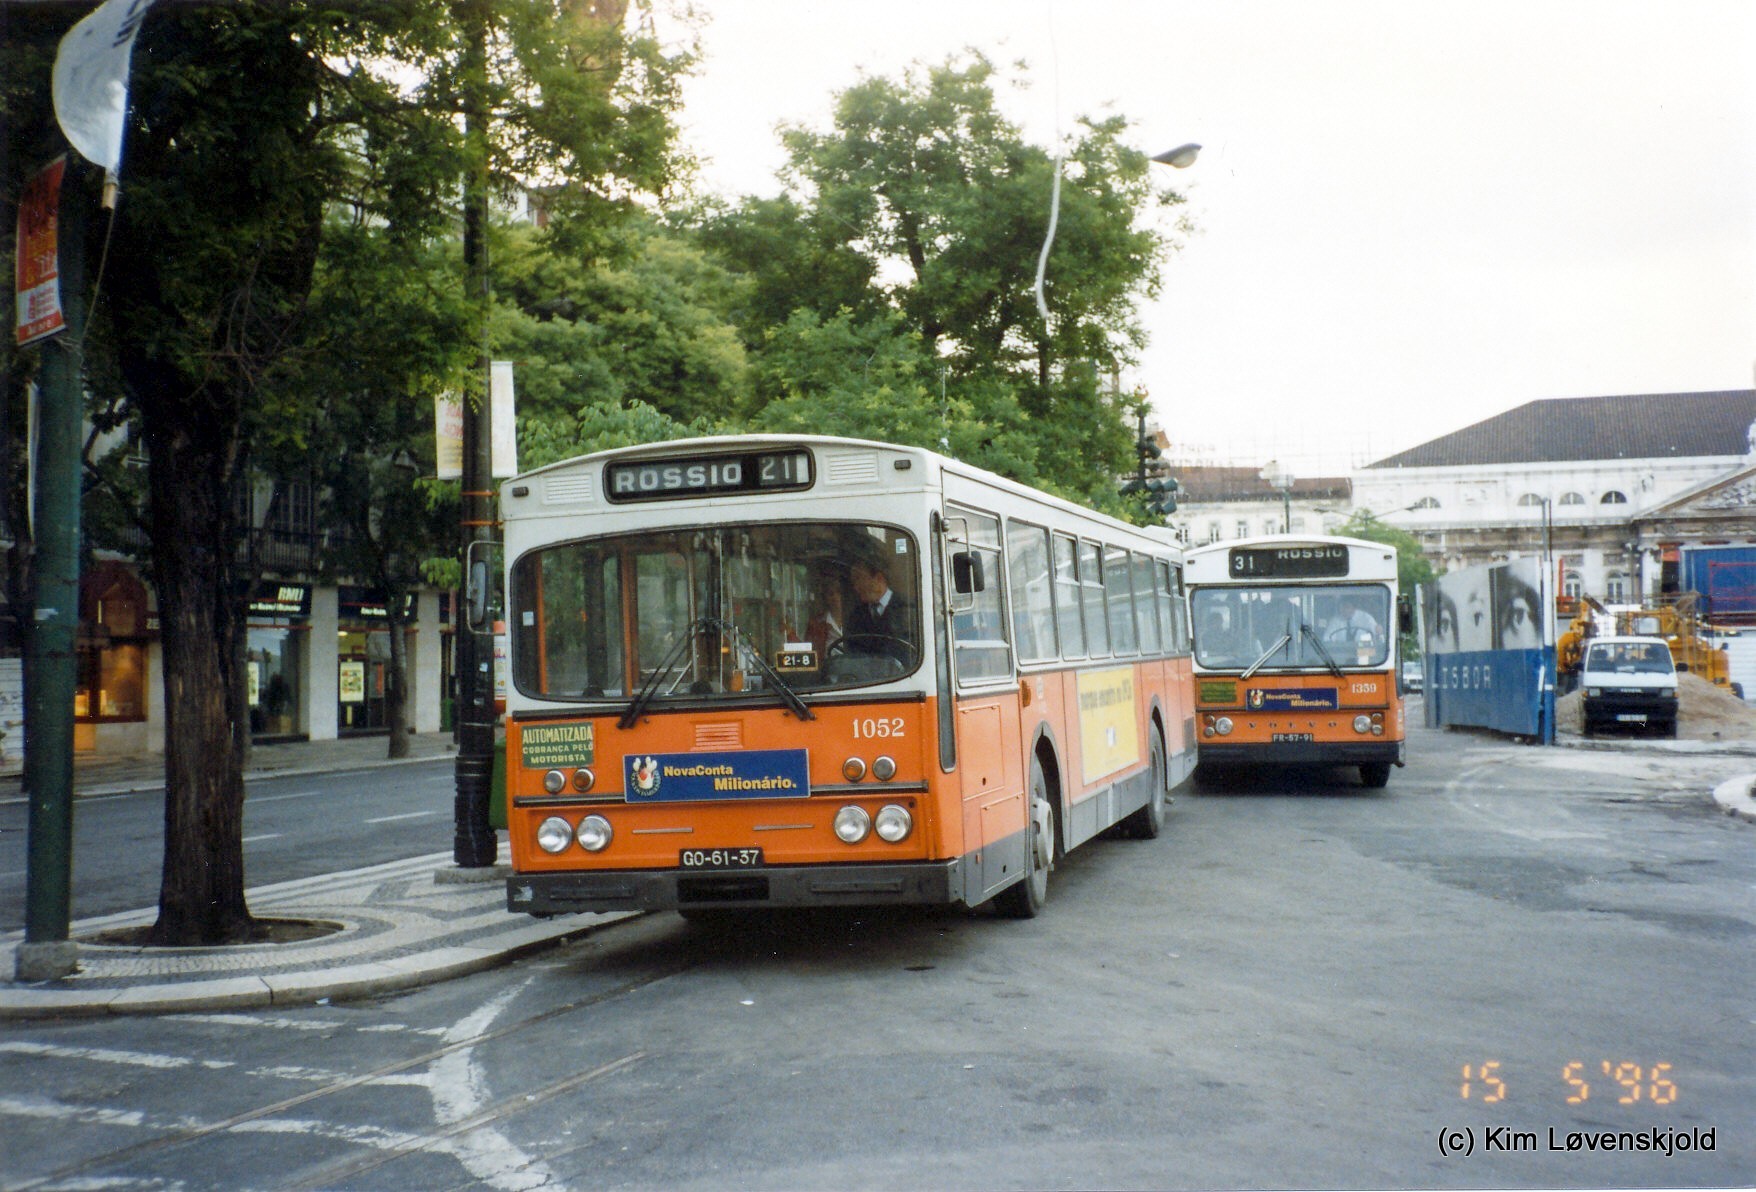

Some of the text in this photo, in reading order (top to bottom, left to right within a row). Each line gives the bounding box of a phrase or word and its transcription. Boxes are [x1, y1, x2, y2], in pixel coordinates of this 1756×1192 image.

[615, 456, 790, 493] ROSSIO 21
[1234, 555, 1254, 573] 31
[783, 655, 810, 666] 21-8
[522, 725, 594, 744] AUTOMATIZADA
[852, 717, 905, 738] 1052
[522, 744, 570, 754] COBRANÇA
[530, 753, 586, 764] MOTORISTA
[664, 765, 733, 777] NovaConta
[713, 775, 797, 791] Milionário.
[683, 849, 759, 866] GO-61-37
